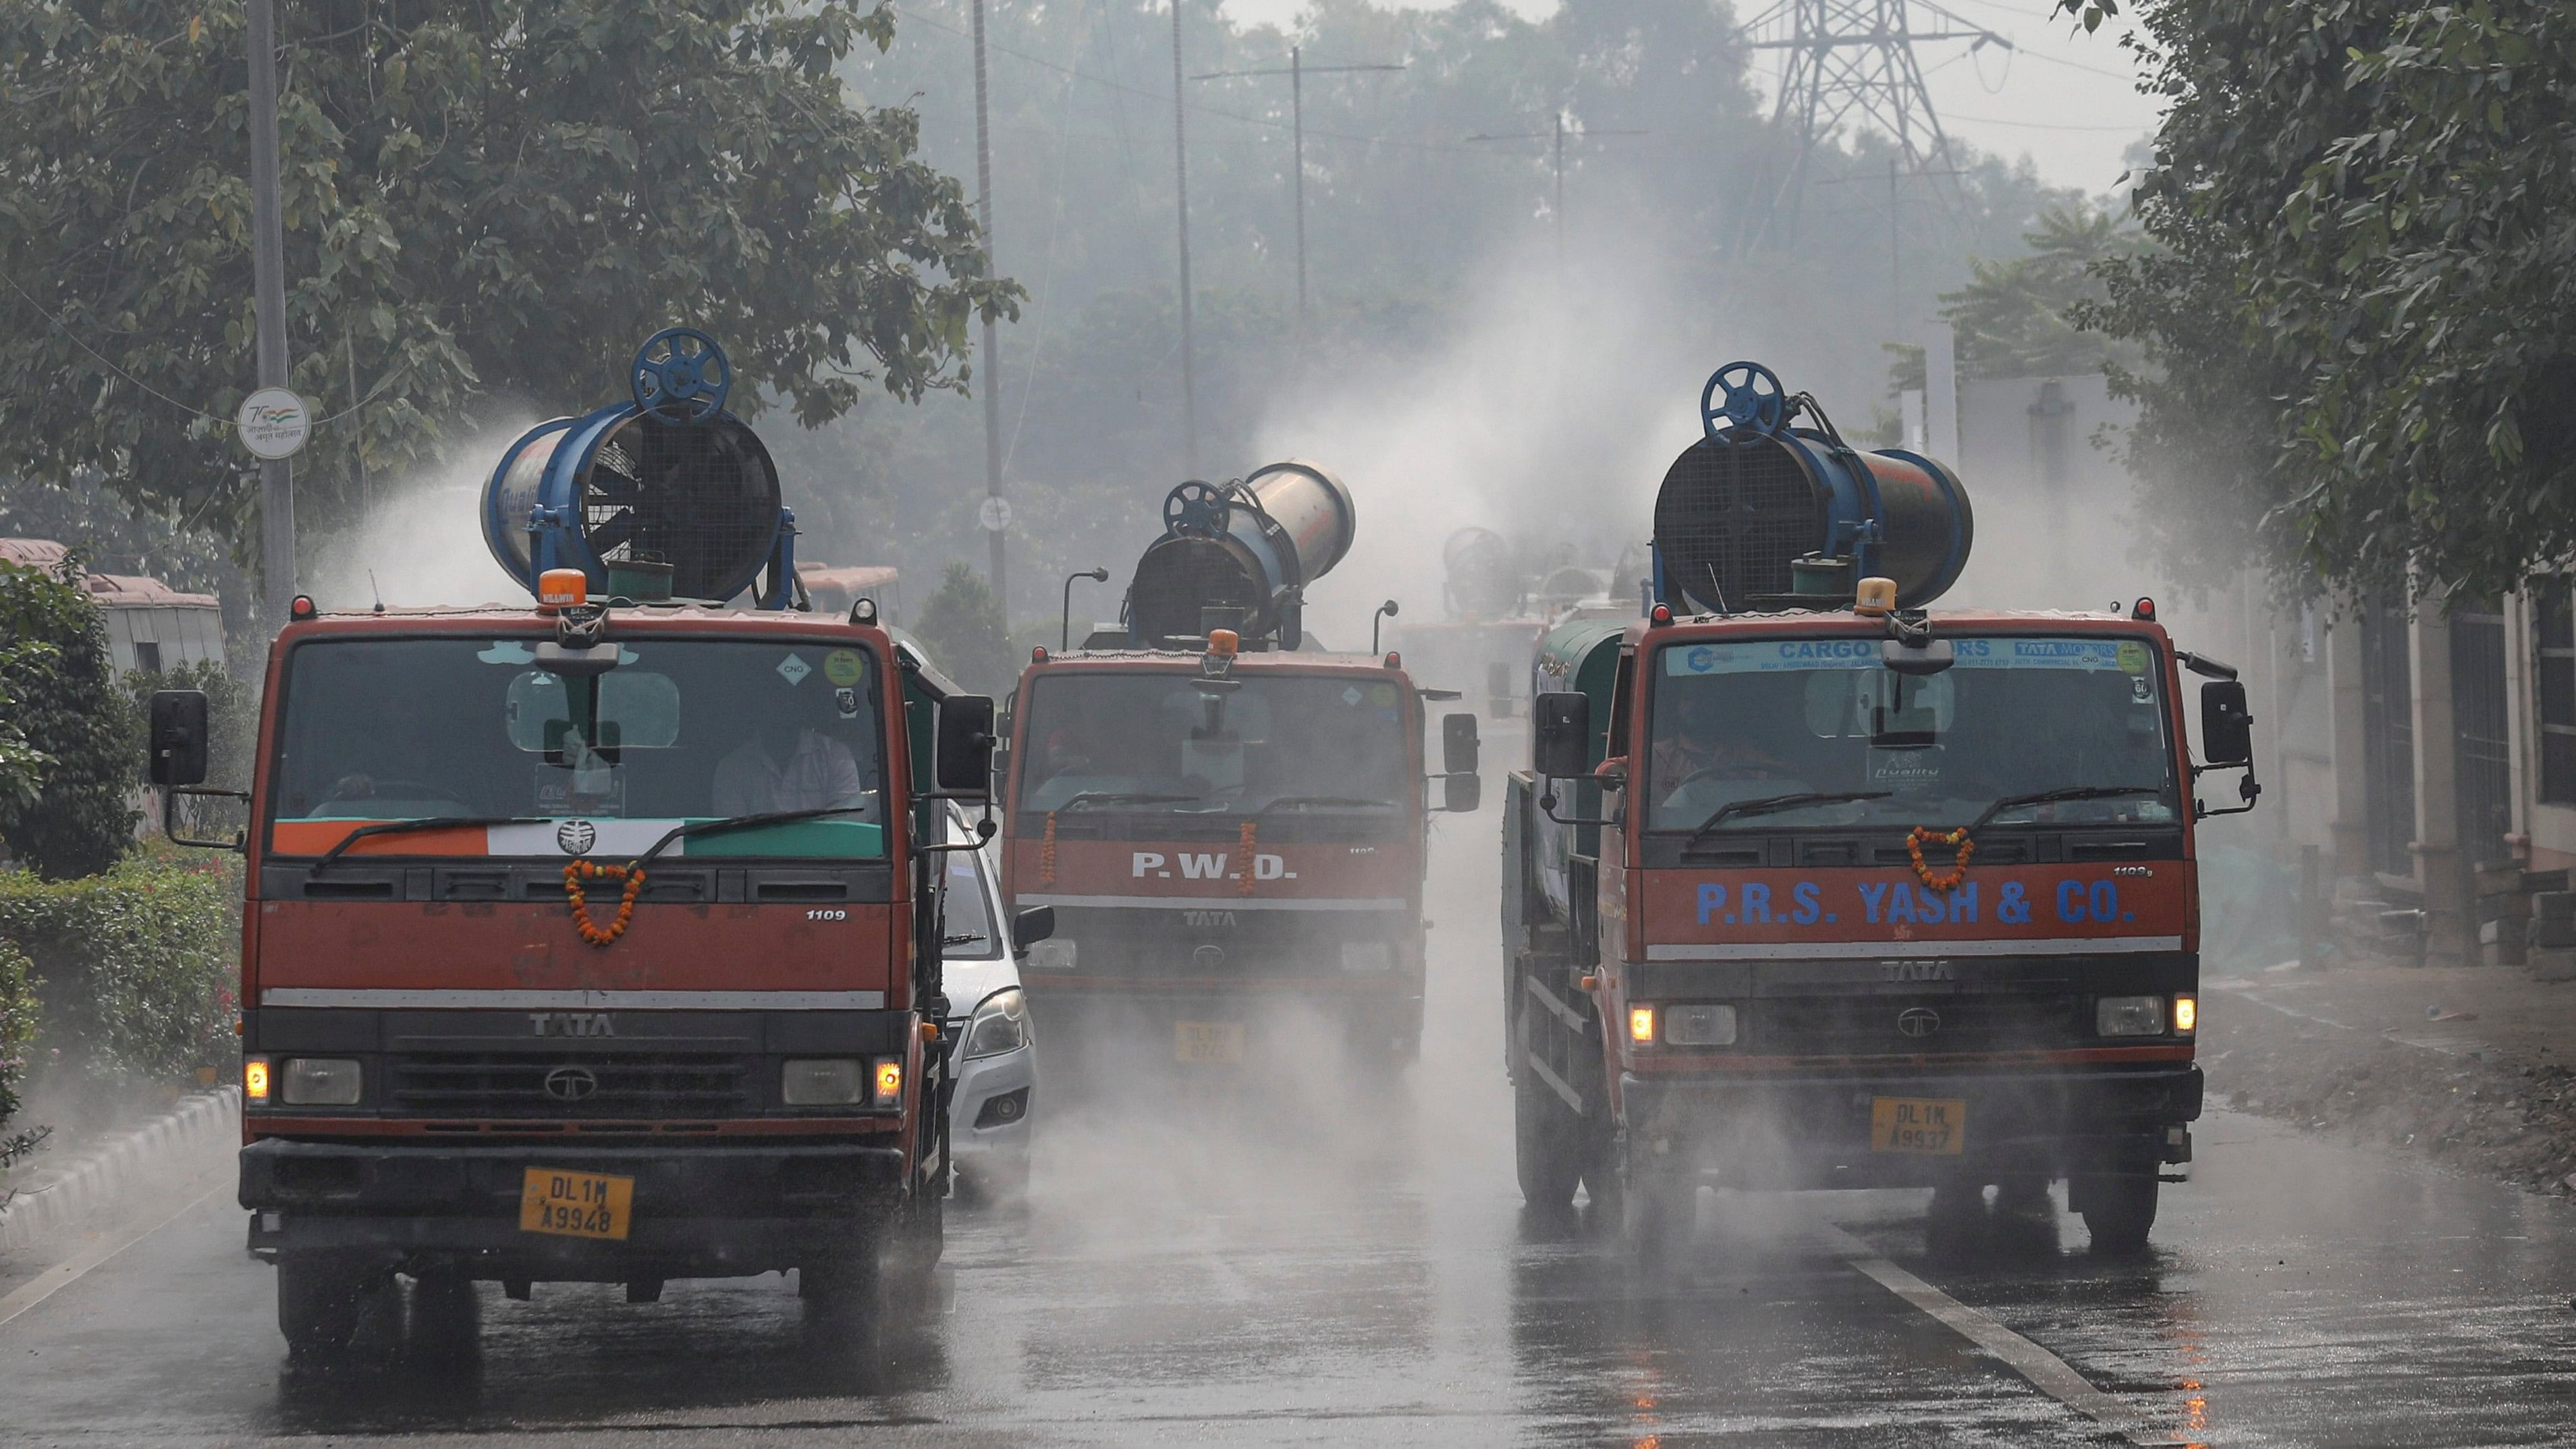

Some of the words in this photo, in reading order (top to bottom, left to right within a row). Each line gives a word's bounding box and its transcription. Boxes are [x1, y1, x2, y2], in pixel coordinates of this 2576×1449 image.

[1779, 641, 1871, 658] CARGO
[2020, 643, 2057, 655] TATA
[2061, 643, 2116, 657] MOTORS
[1696, 880, 1837, 925] P.R.S.
[1857, 881, 1979, 924] YASH
[1997, 880, 2033, 923] &
[2056, 879, 2135, 923] CO.
[806, 909, 846, 921] 1109
[1183, 911, 1236, 926] TATA
[1881, 960, 1955, 981] TATA
[528, 1013, 615, 1037] TATA
[541, 1204, 611, 1233] A9948
